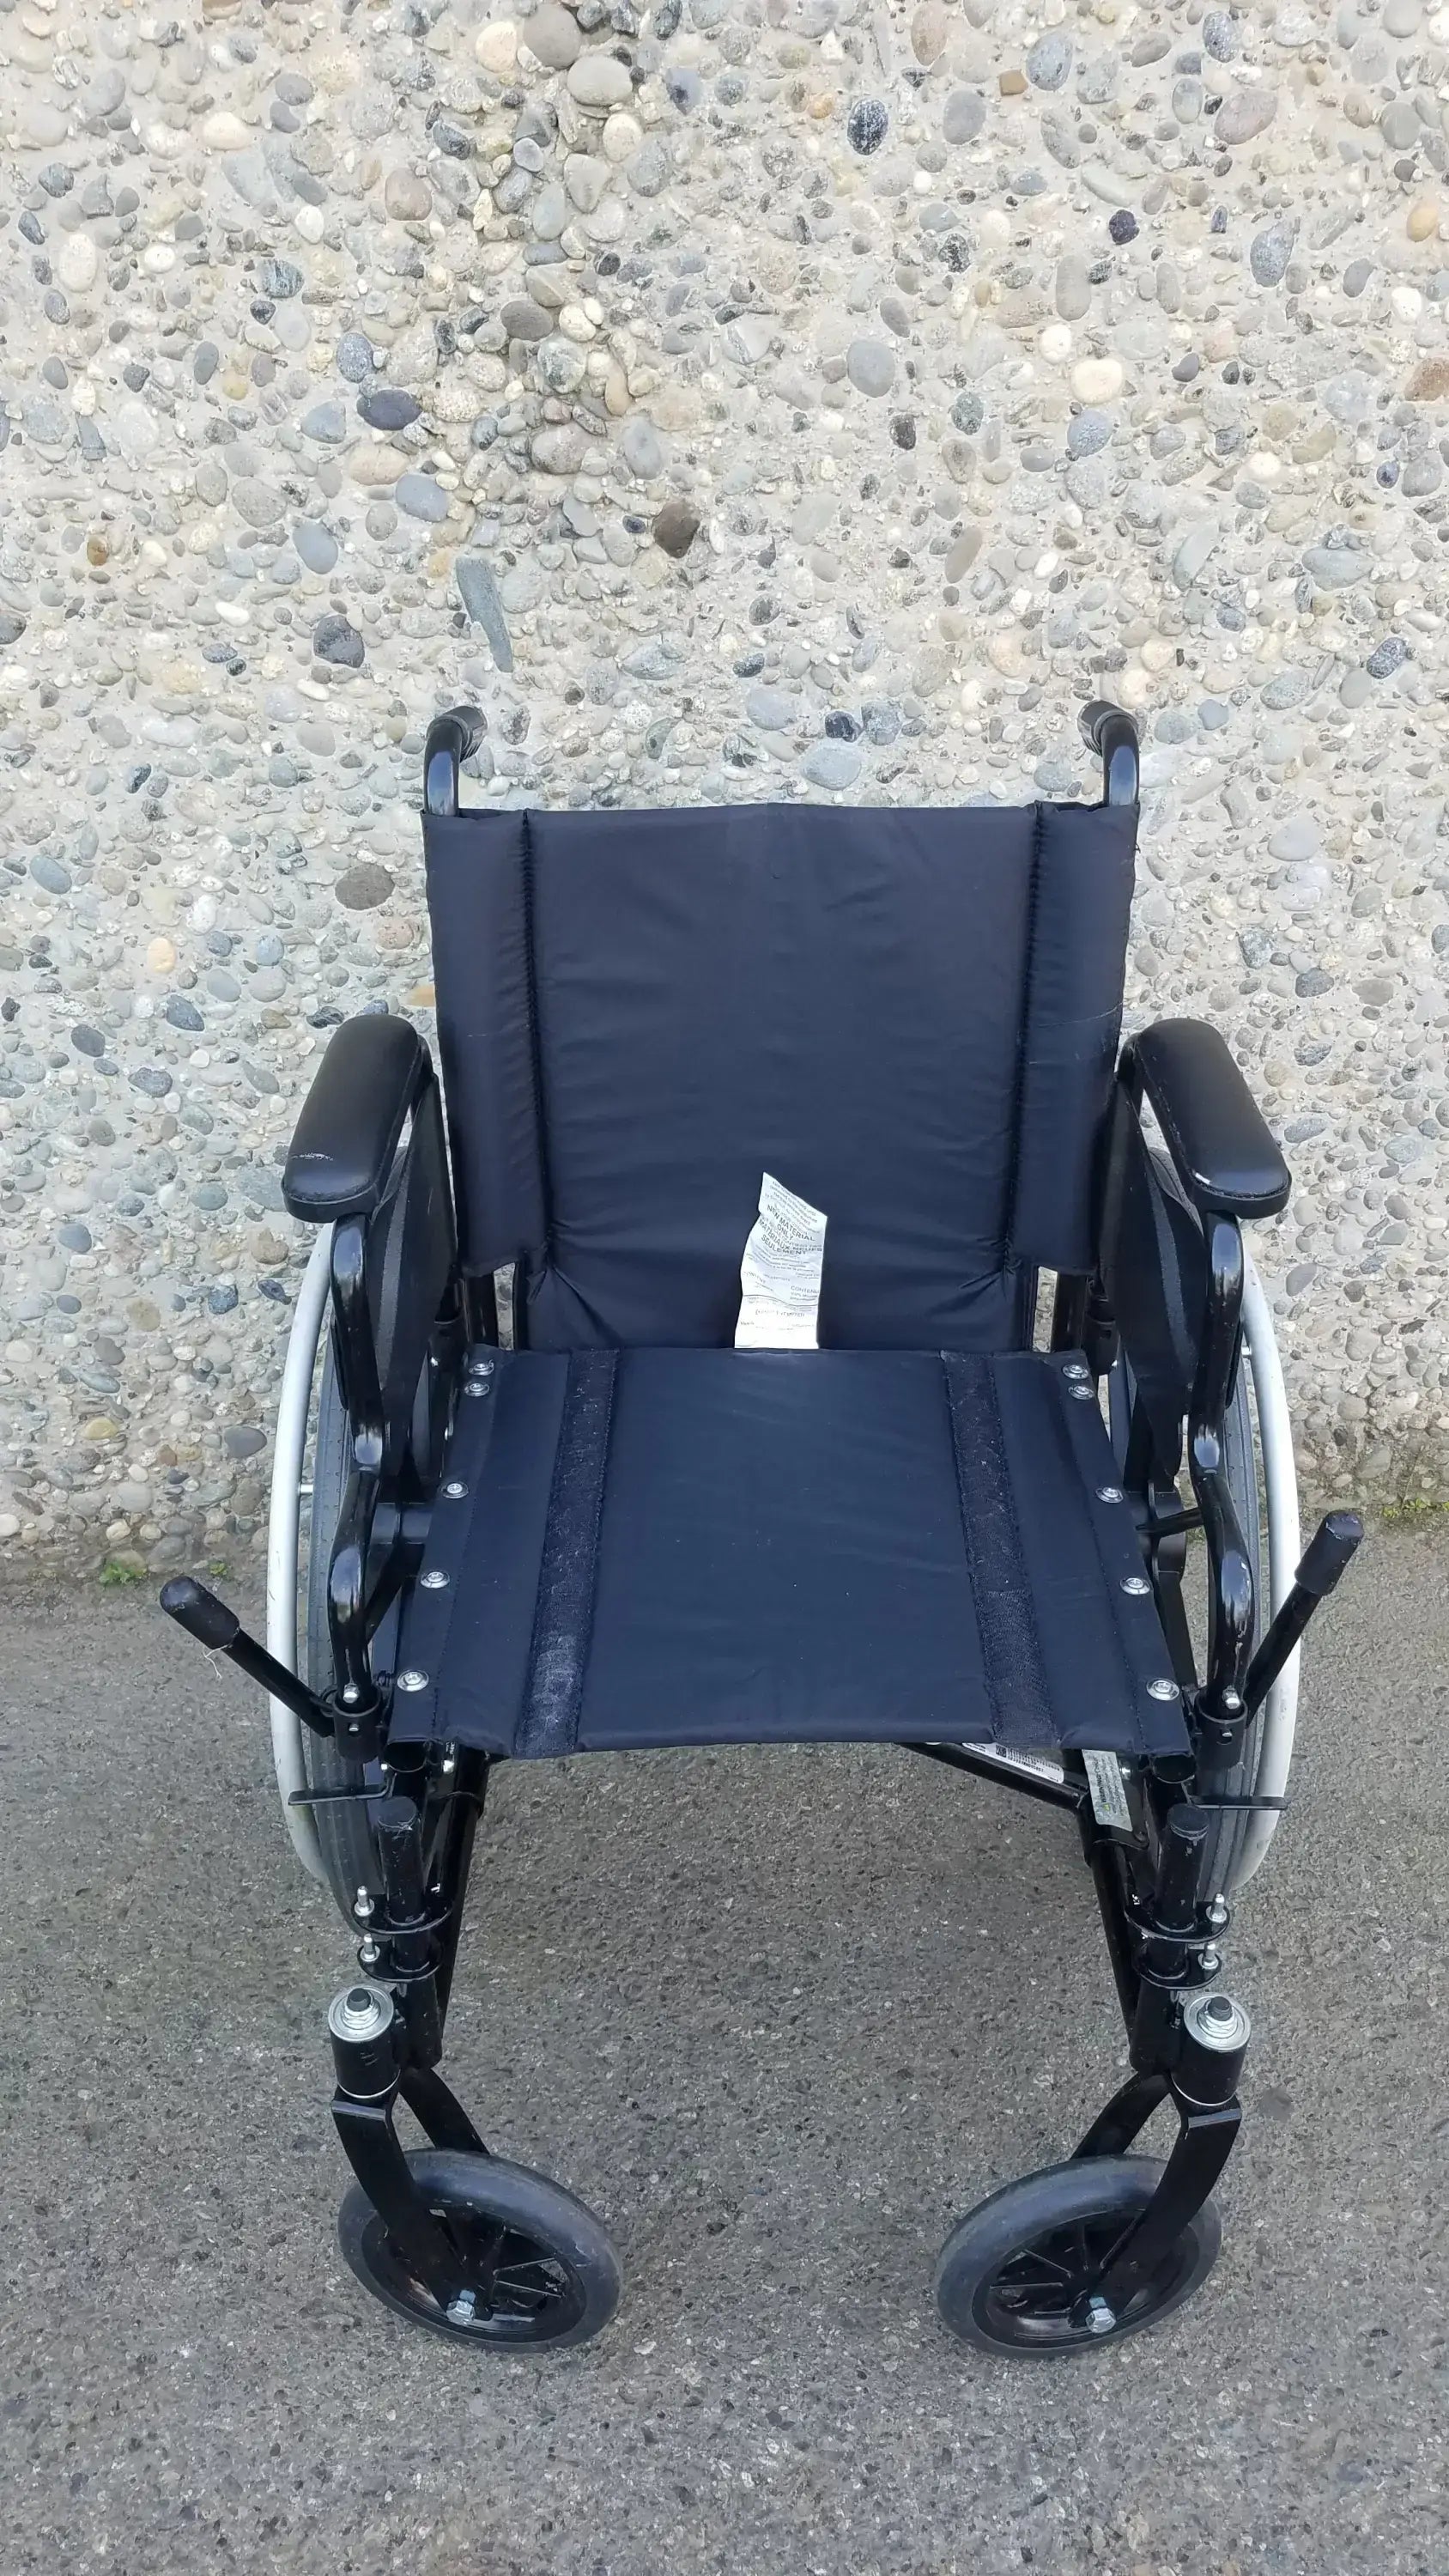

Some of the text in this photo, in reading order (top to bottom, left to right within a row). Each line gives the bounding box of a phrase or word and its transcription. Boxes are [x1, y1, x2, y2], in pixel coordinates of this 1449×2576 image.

[777, 1224, 794, 1241] ONLY
[779, 1217, 816, 1242] MATERIAL
[761, 1234, 806, 1255] SEULEMENT
